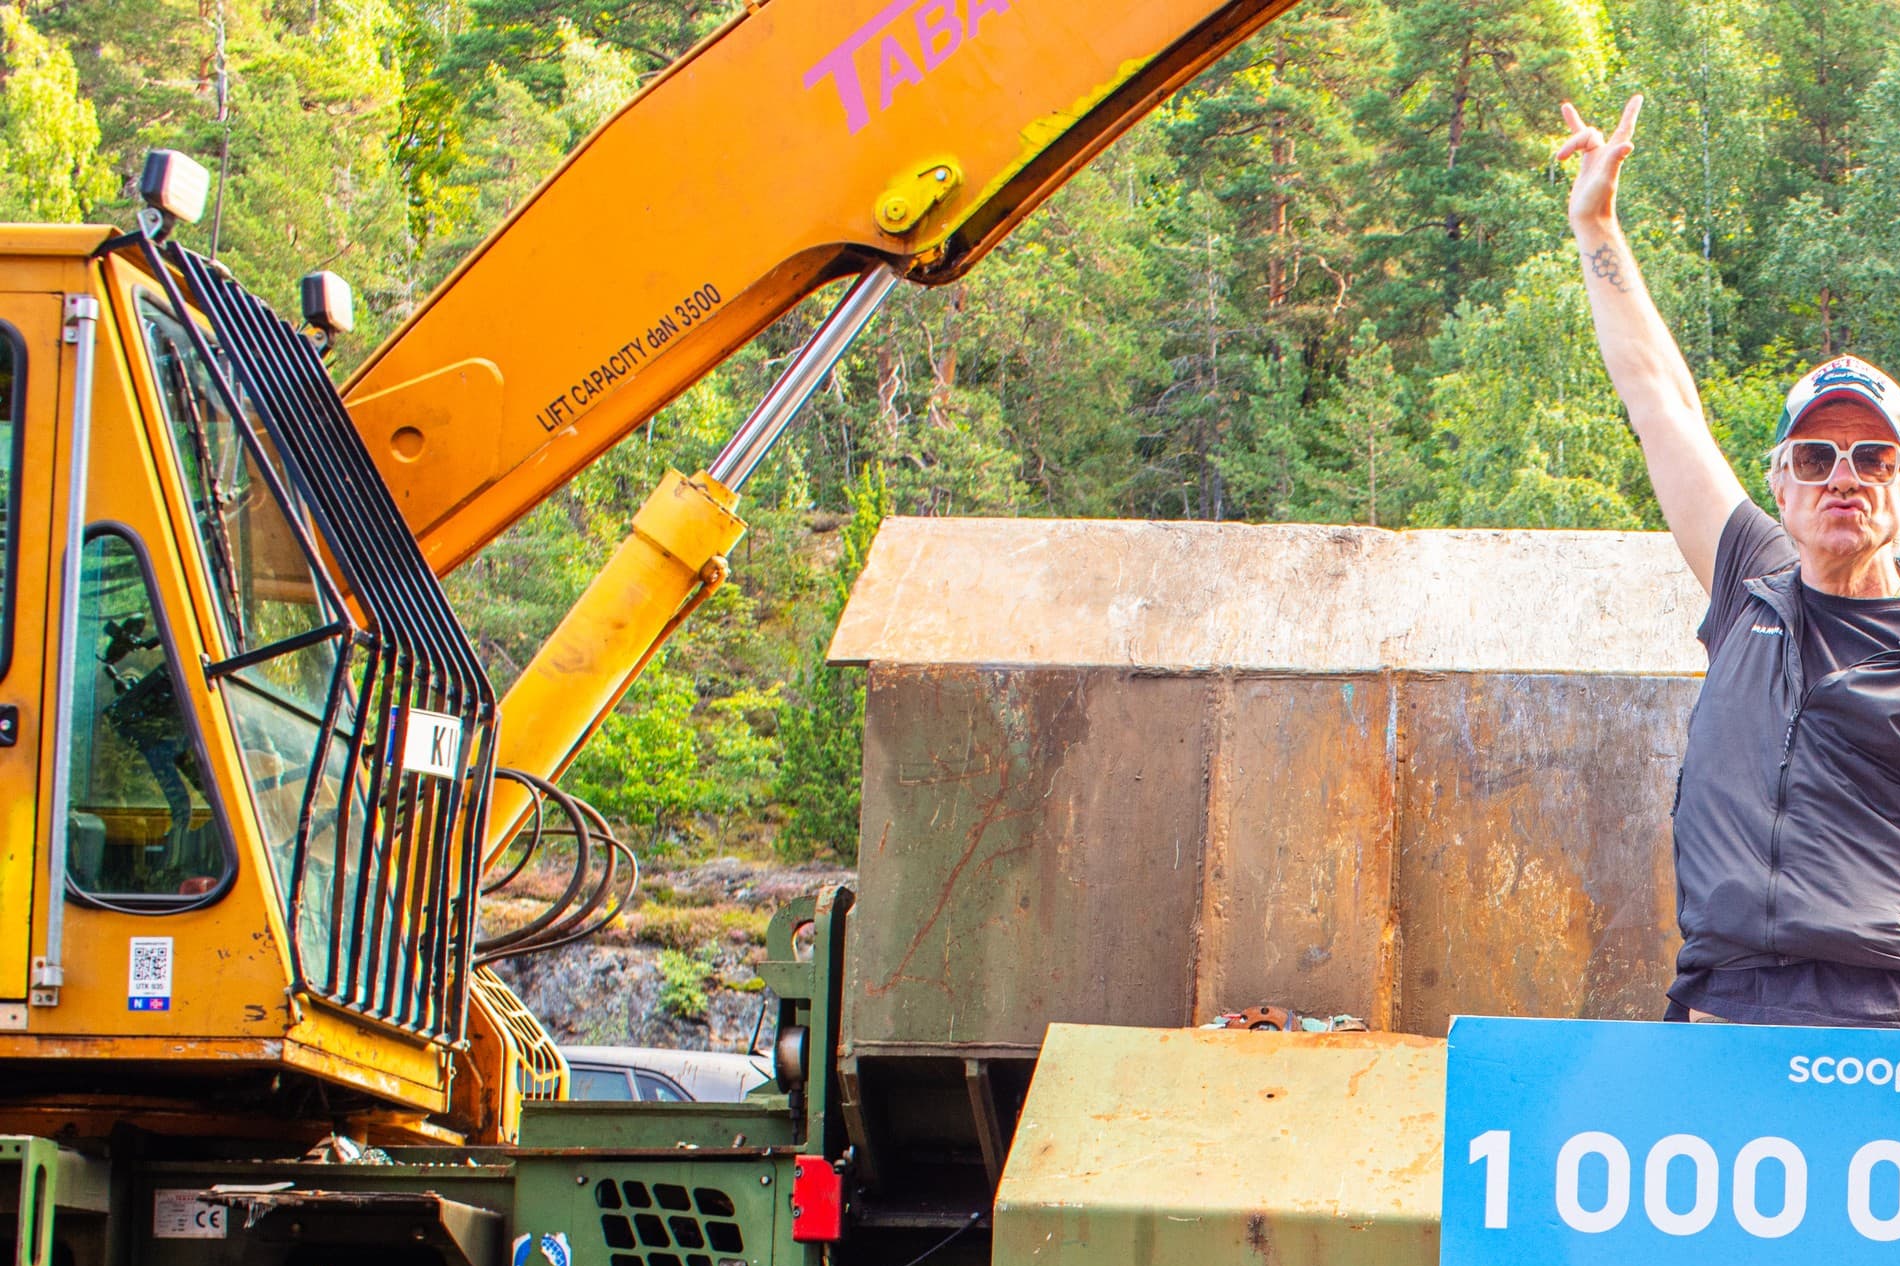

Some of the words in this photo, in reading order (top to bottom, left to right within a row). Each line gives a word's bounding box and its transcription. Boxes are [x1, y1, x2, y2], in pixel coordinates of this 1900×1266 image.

[536, 395, 575, 432] LIFT
[571, 337, 648, 406] CAPACITY
[646, 314, 680, 349] daN
[674, 282, 722, 327] 3500
[1469, 1130, 1511, 1229] 1
[1555, 1131, 1808, 1239] 000
